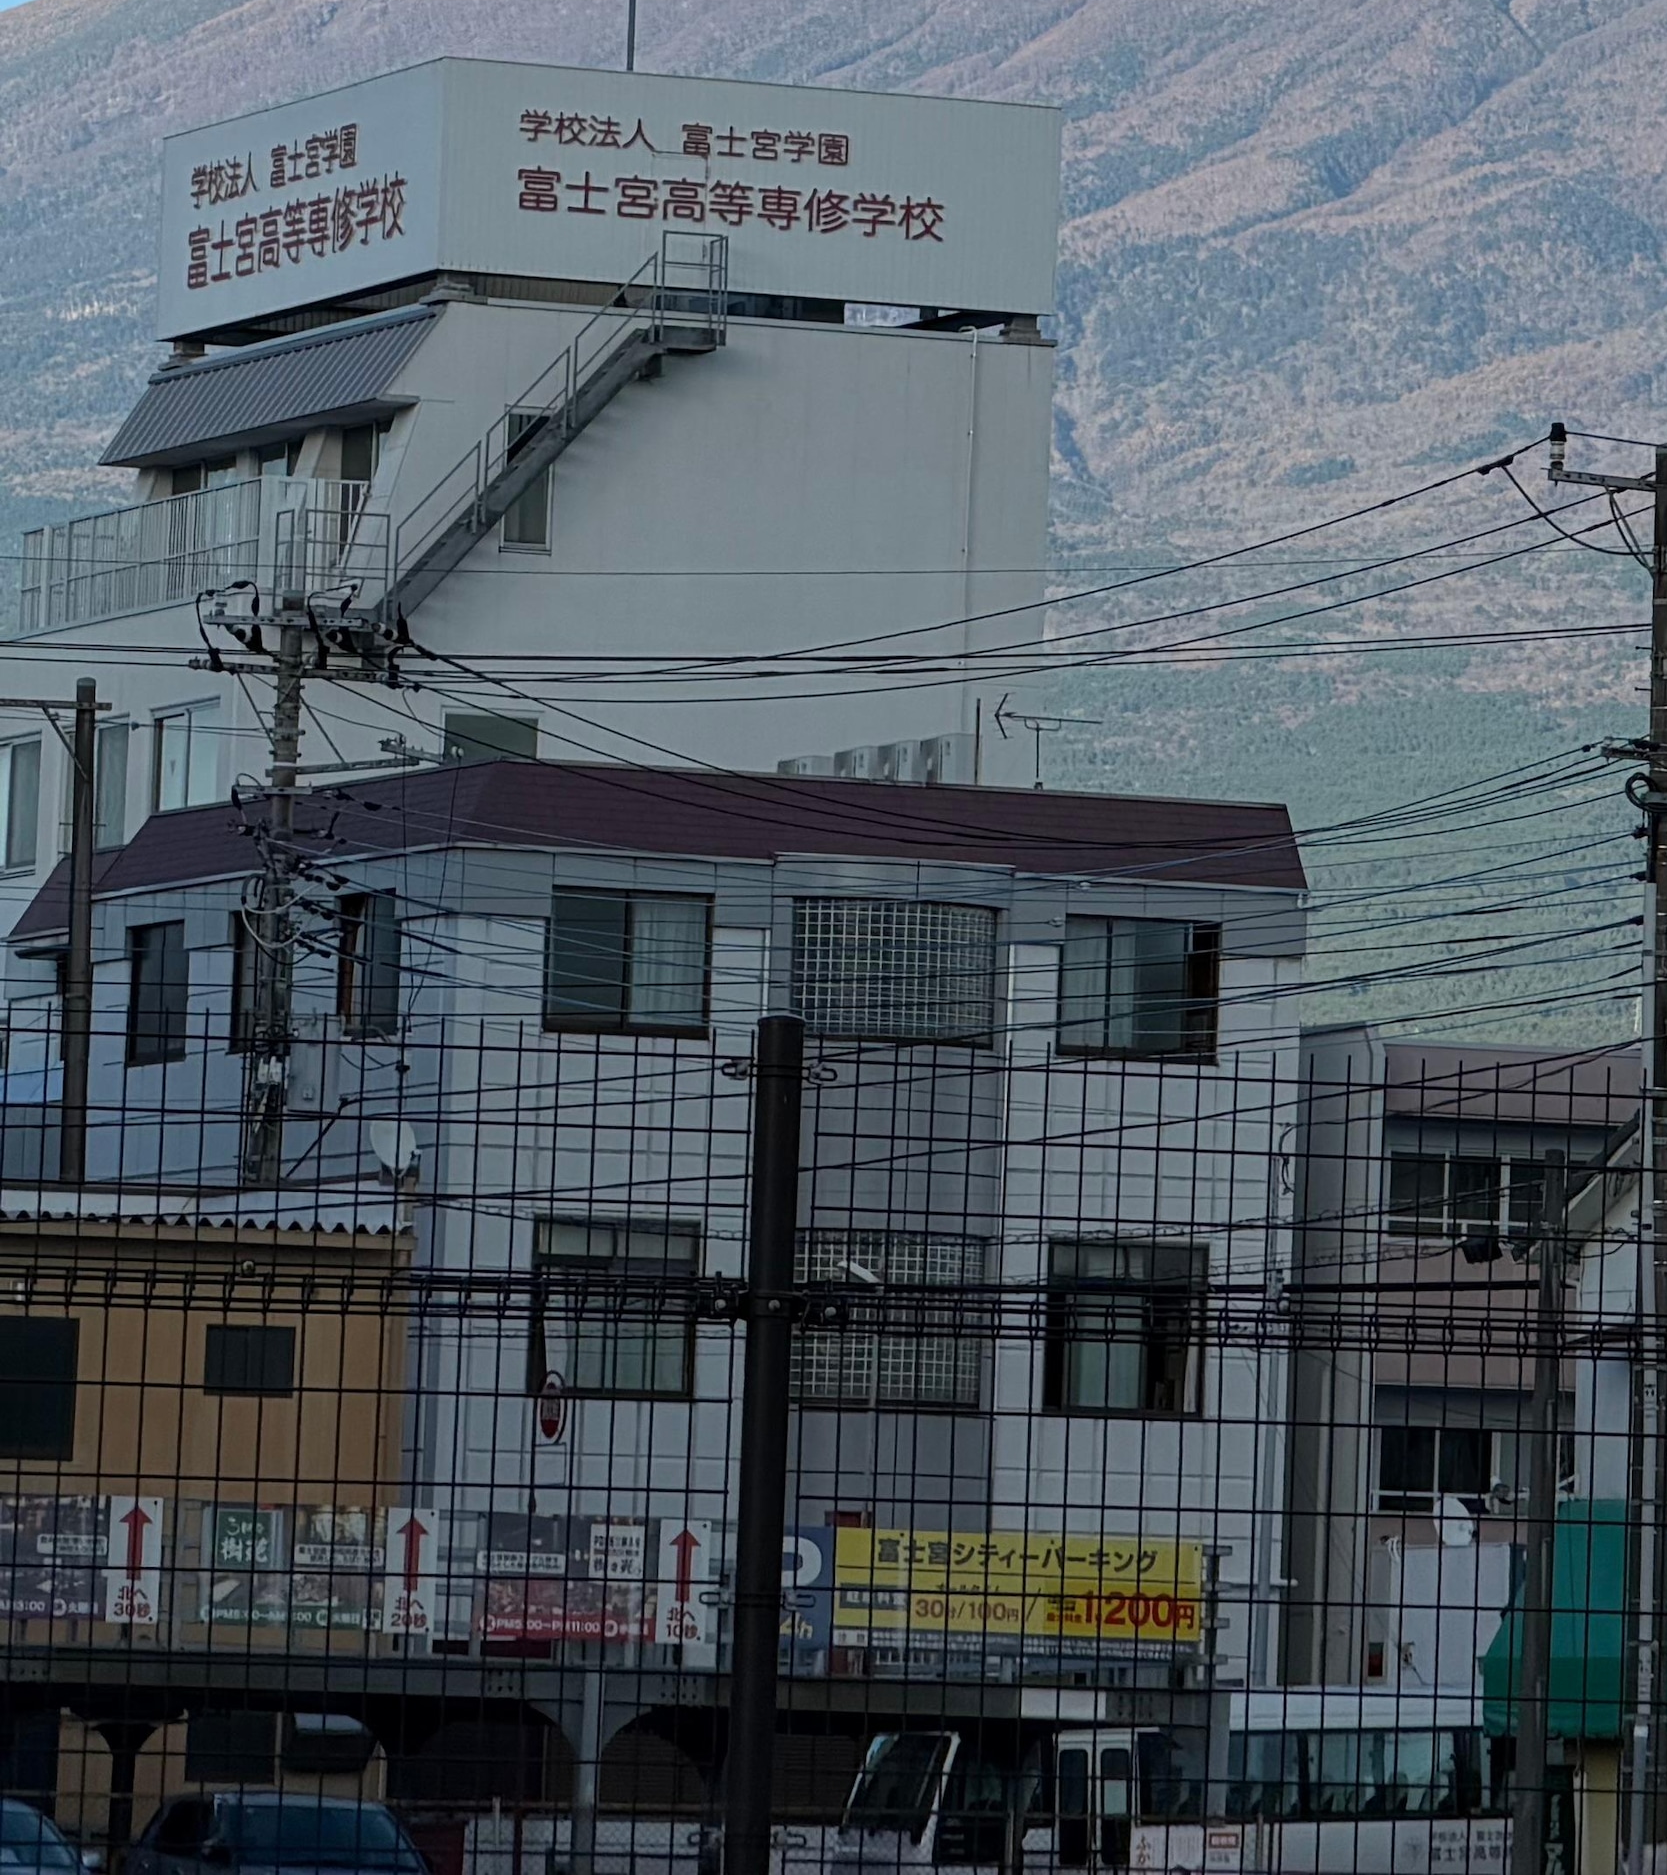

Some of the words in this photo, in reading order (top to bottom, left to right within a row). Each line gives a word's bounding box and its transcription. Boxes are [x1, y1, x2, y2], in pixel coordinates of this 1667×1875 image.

[190, 150, 260, 210] 学校法人
[269, 122, 359, 190] 富士宮学園
[519, 109, 656, 152] 学校法人
[680, 122, 850, 167] 富士宮学園
[186, 171, 408, 290] 富士宮高等専修学校
[517, 166, 946, 243] 富士宮高等専修学校
